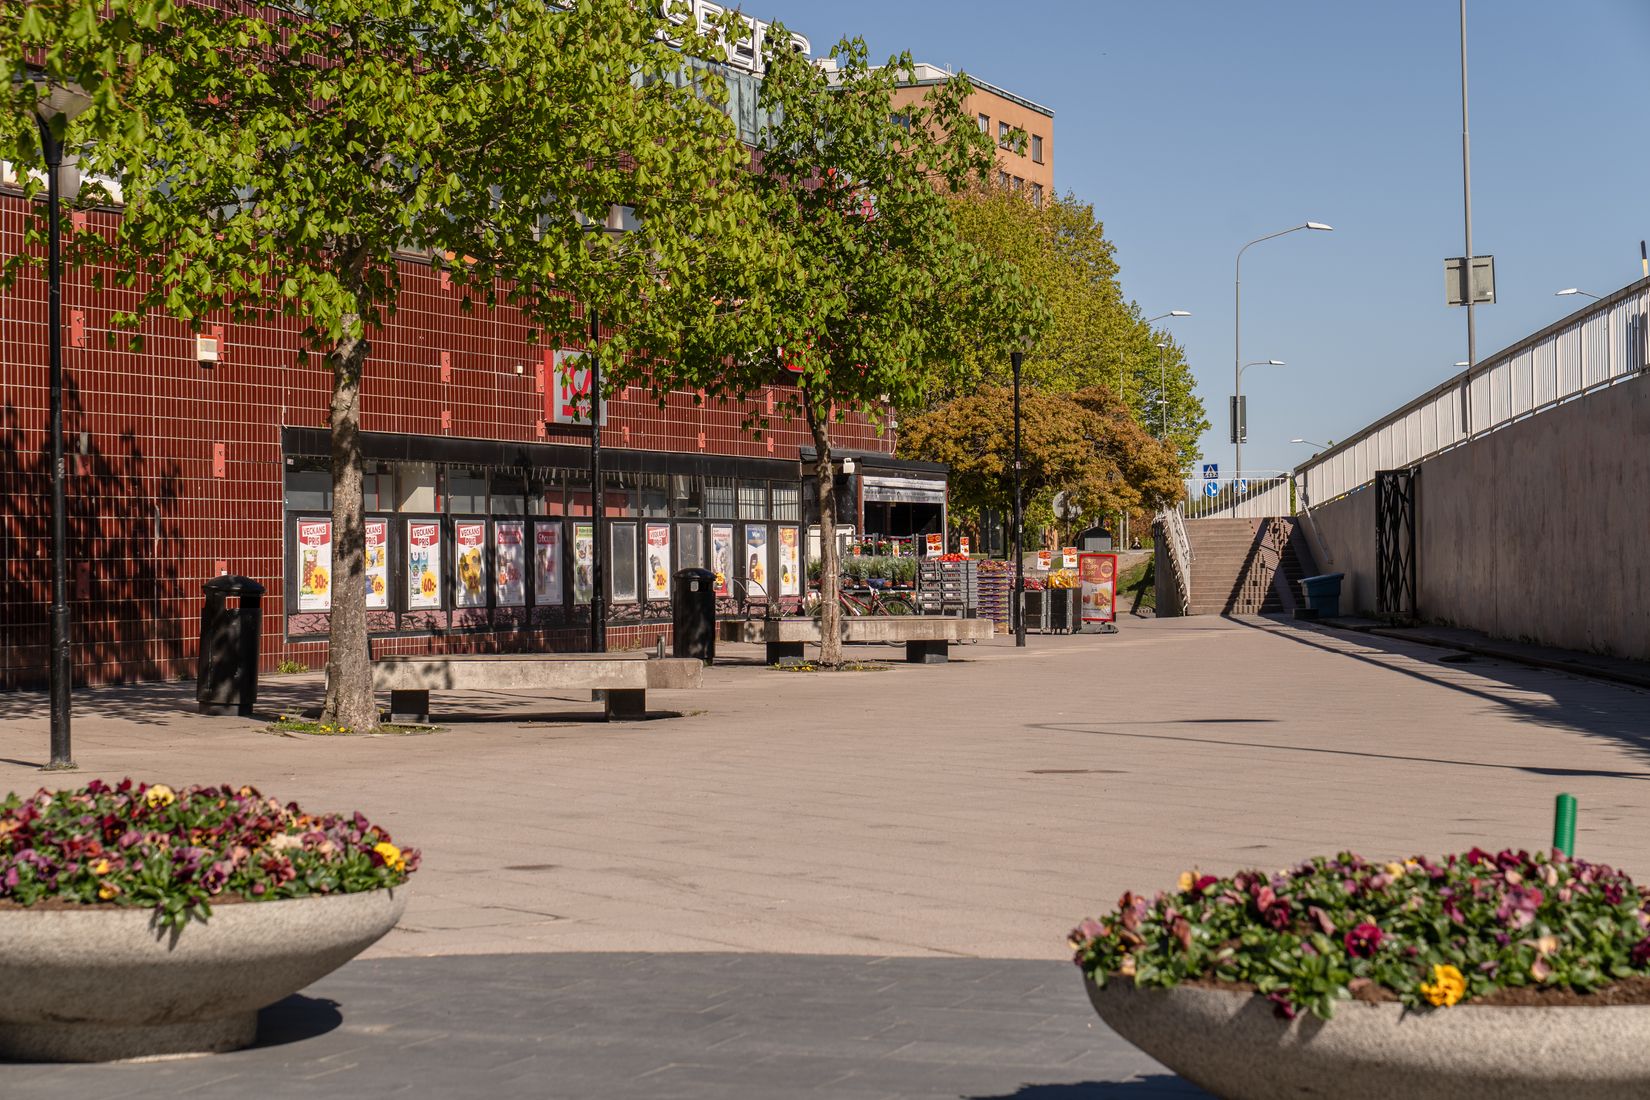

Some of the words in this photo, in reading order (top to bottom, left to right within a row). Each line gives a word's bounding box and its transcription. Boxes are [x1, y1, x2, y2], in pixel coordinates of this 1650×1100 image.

[302, 525, 326, 536] VECKANS
[366, 525, 382, 535] CKANS
[413, 527, 434, 537] VECKANS
[460, 527, 480, 537] VECKANS
[308, 536, 320, 545] PRIS
[418, 537, 429, 546] PRIS
[466, 538, 476, 546] PRIS
[424, 578, 436, 592] 60:-
